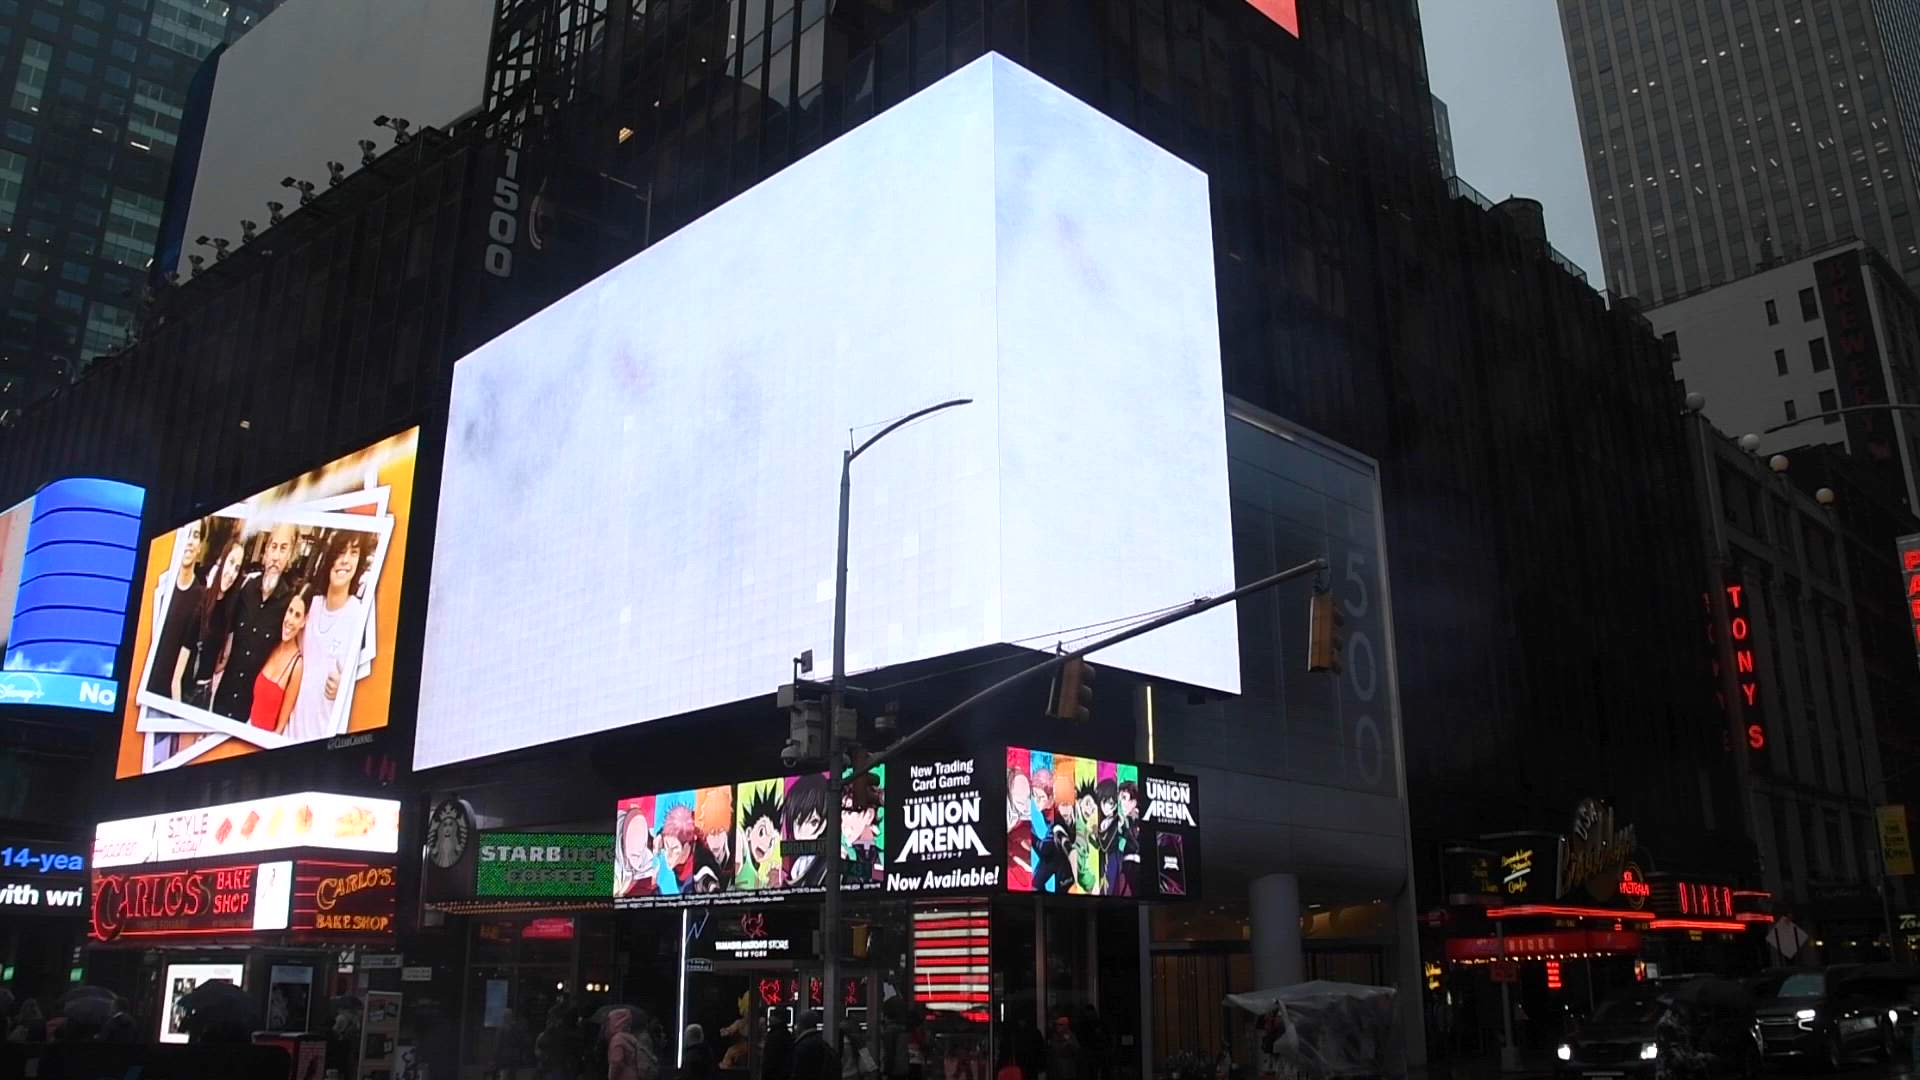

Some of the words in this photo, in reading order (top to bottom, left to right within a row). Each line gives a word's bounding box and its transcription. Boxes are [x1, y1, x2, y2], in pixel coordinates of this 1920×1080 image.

[485, 149, 520, 278] 1500
[80, 681, 115, 705] No
[911, 765, 933, 779] New
[934, 759, 974, 775] Trading
[912, 777, 936, 791] Card
[939, 774, 971, 789] Game
[1146, 781, 1190, 805] UNION
[903, 797, 981, 829] UNION
[1142, 800, 1197, 827] ARENA
[893, 824, 992, 863] ARENA
[1, 847, 83, 873] 14-yea
[217, 869, 251, 890] BAKE
[506, 868, 594, 884] COFFEE
[887, 873, 921, 892] Now
[922, 865, 1000, 889] Available!
[213, 893, 249, 913] SHOP
[316, 913, 351, 929] BAKE
[352, 915, 389, 930] SHOP
